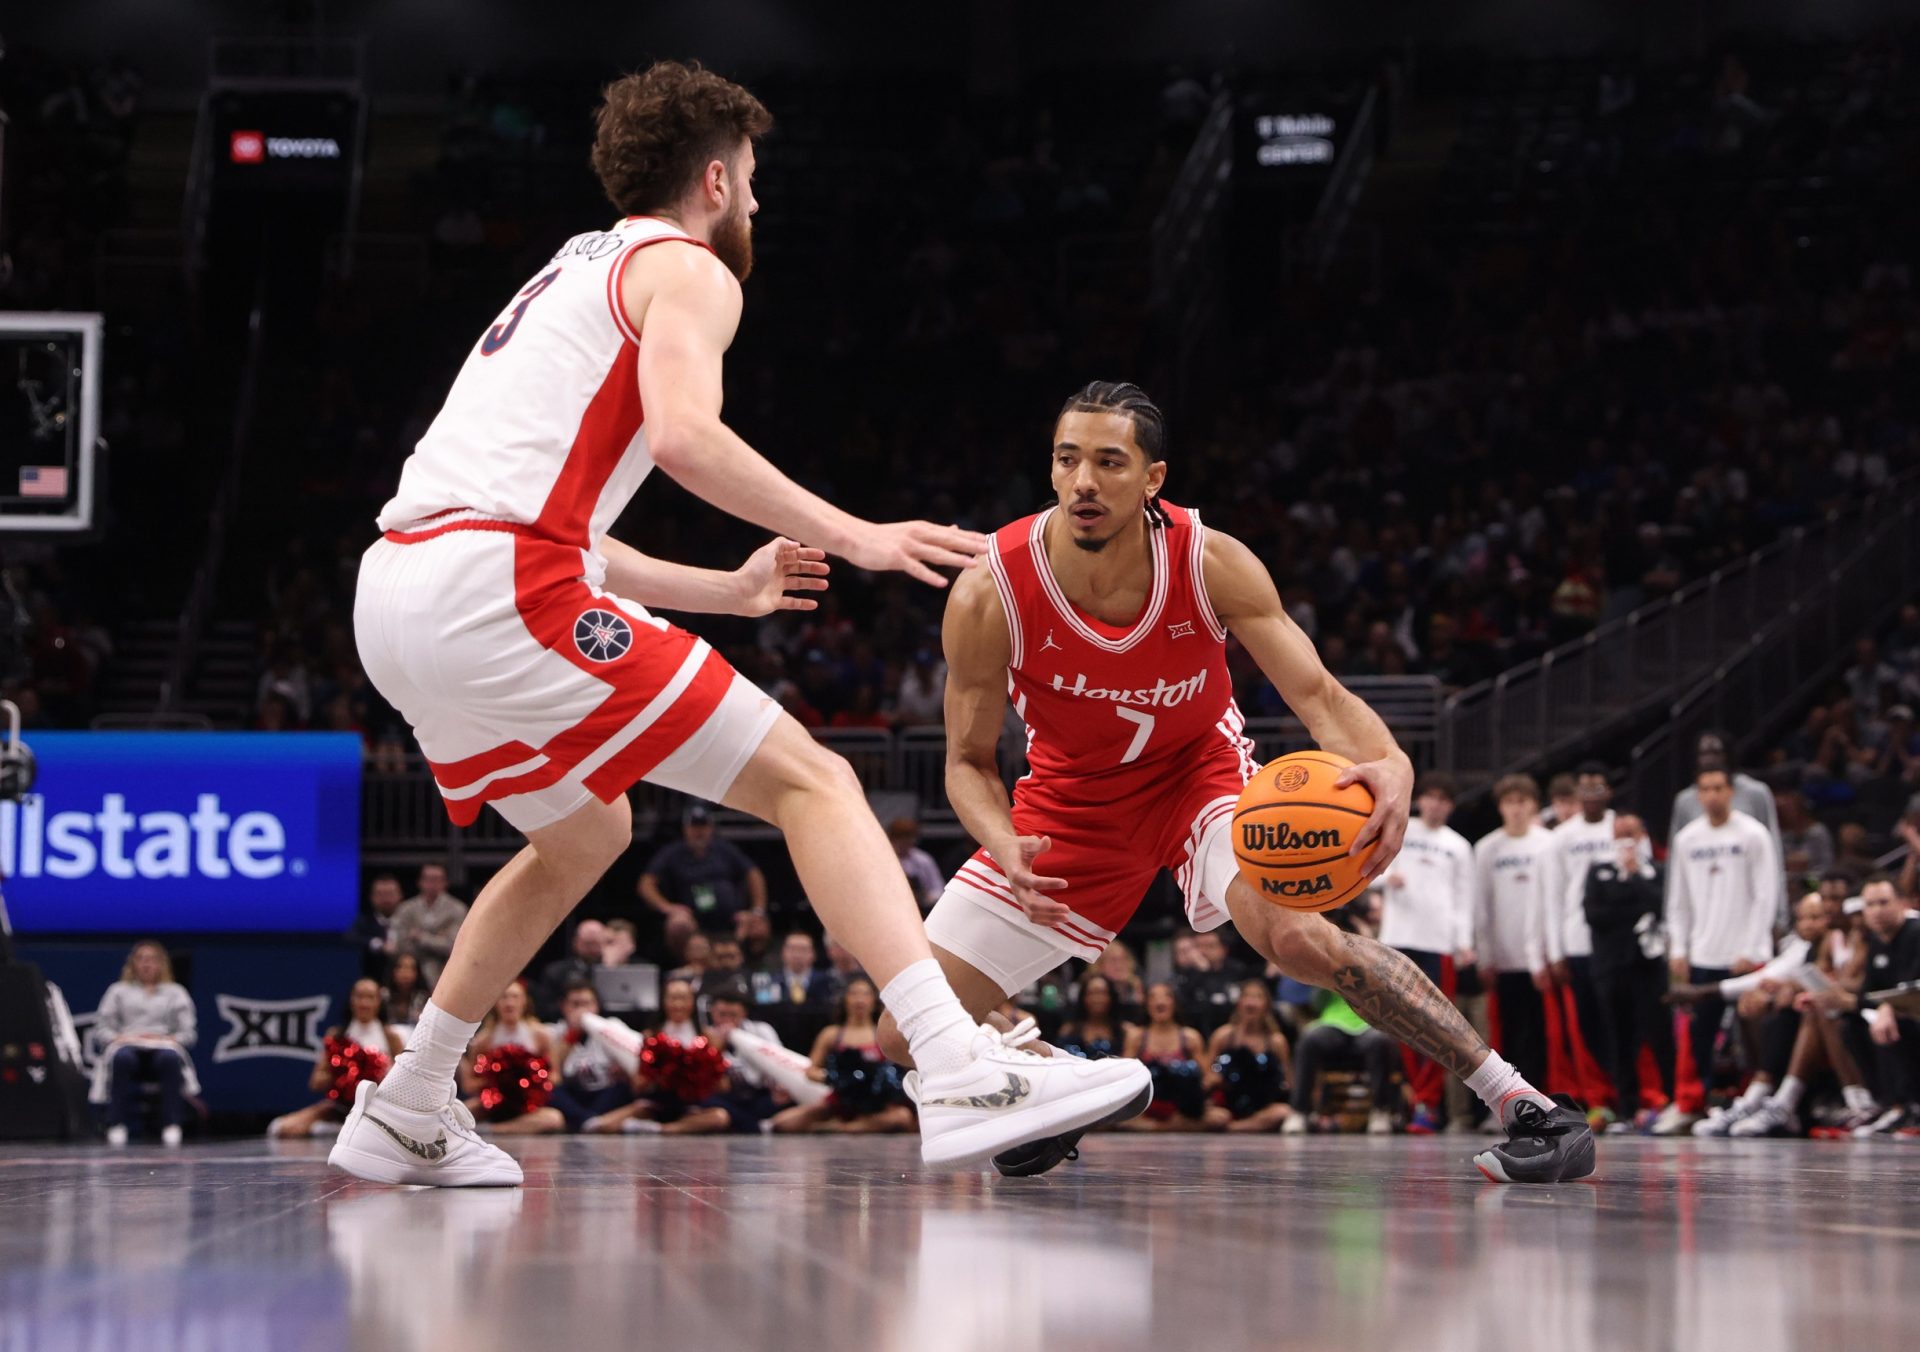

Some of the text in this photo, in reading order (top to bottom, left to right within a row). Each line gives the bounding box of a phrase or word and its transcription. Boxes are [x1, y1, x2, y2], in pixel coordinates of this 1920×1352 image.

[266, 137, 340, 158] TOYOTA
[480, 267, 562, 357] 3
[1047, 669, 1207, 707] Houston
[1116, 705, 1155, 764] 7
[1242, 822, 1341, 851] Wilson
[1260, 873, 1333, 897] NCAA
[225, 1004, 320, 1052] XII
